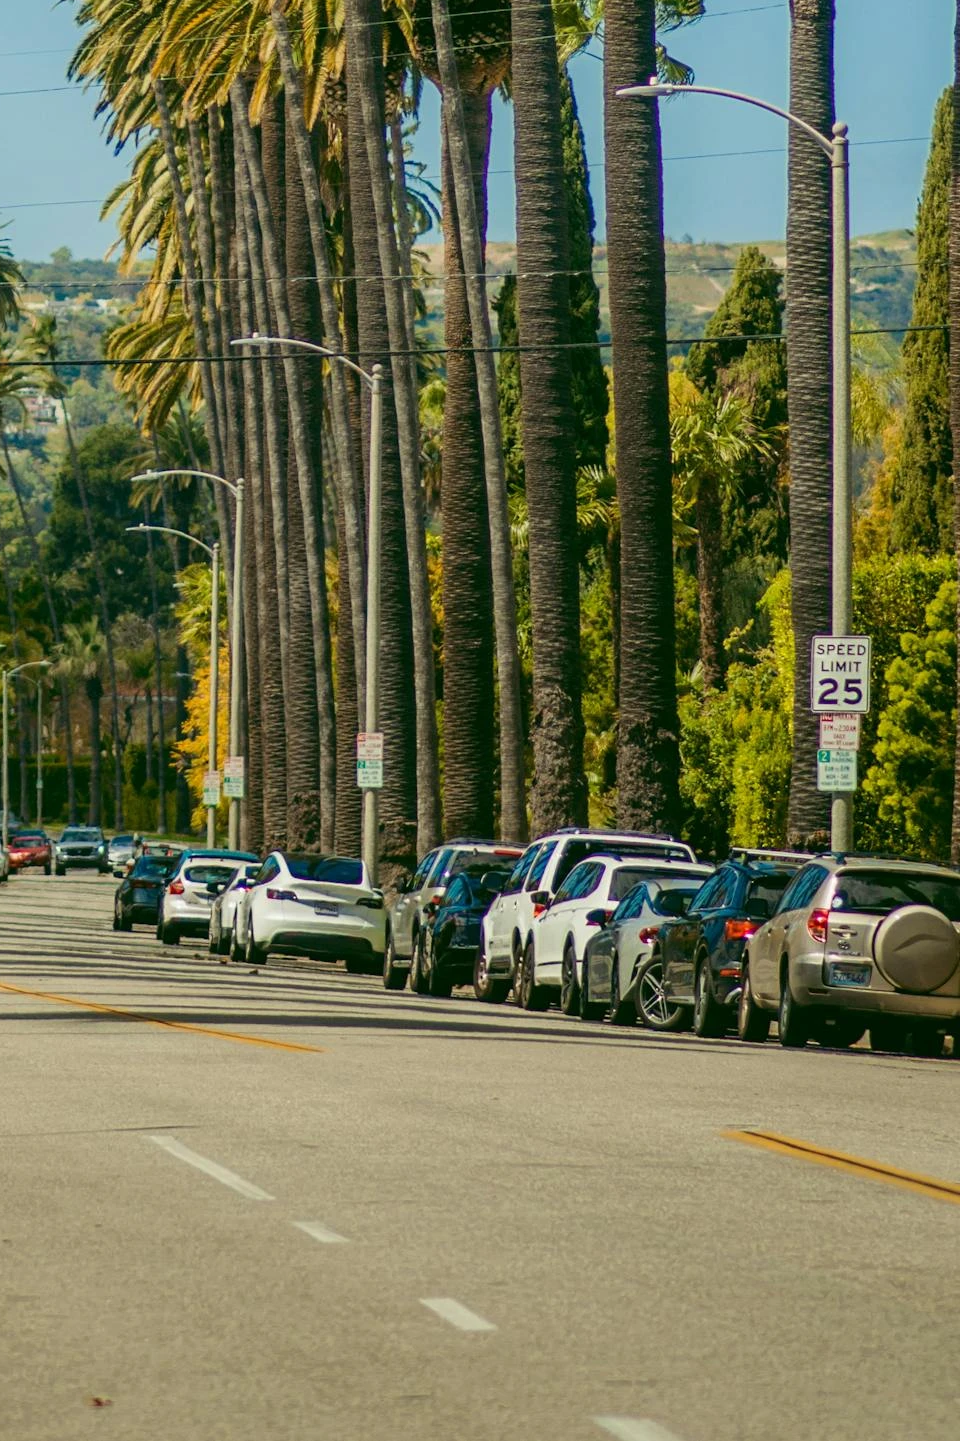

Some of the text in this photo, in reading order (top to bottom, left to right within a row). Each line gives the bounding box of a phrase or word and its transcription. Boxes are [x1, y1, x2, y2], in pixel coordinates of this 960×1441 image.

[817, 644, 866, 656] SPEED
[821, 661, 862, 672] LIMIT
[818, 677, 863, 705] 25
[821, 751, 828, 762] 2
